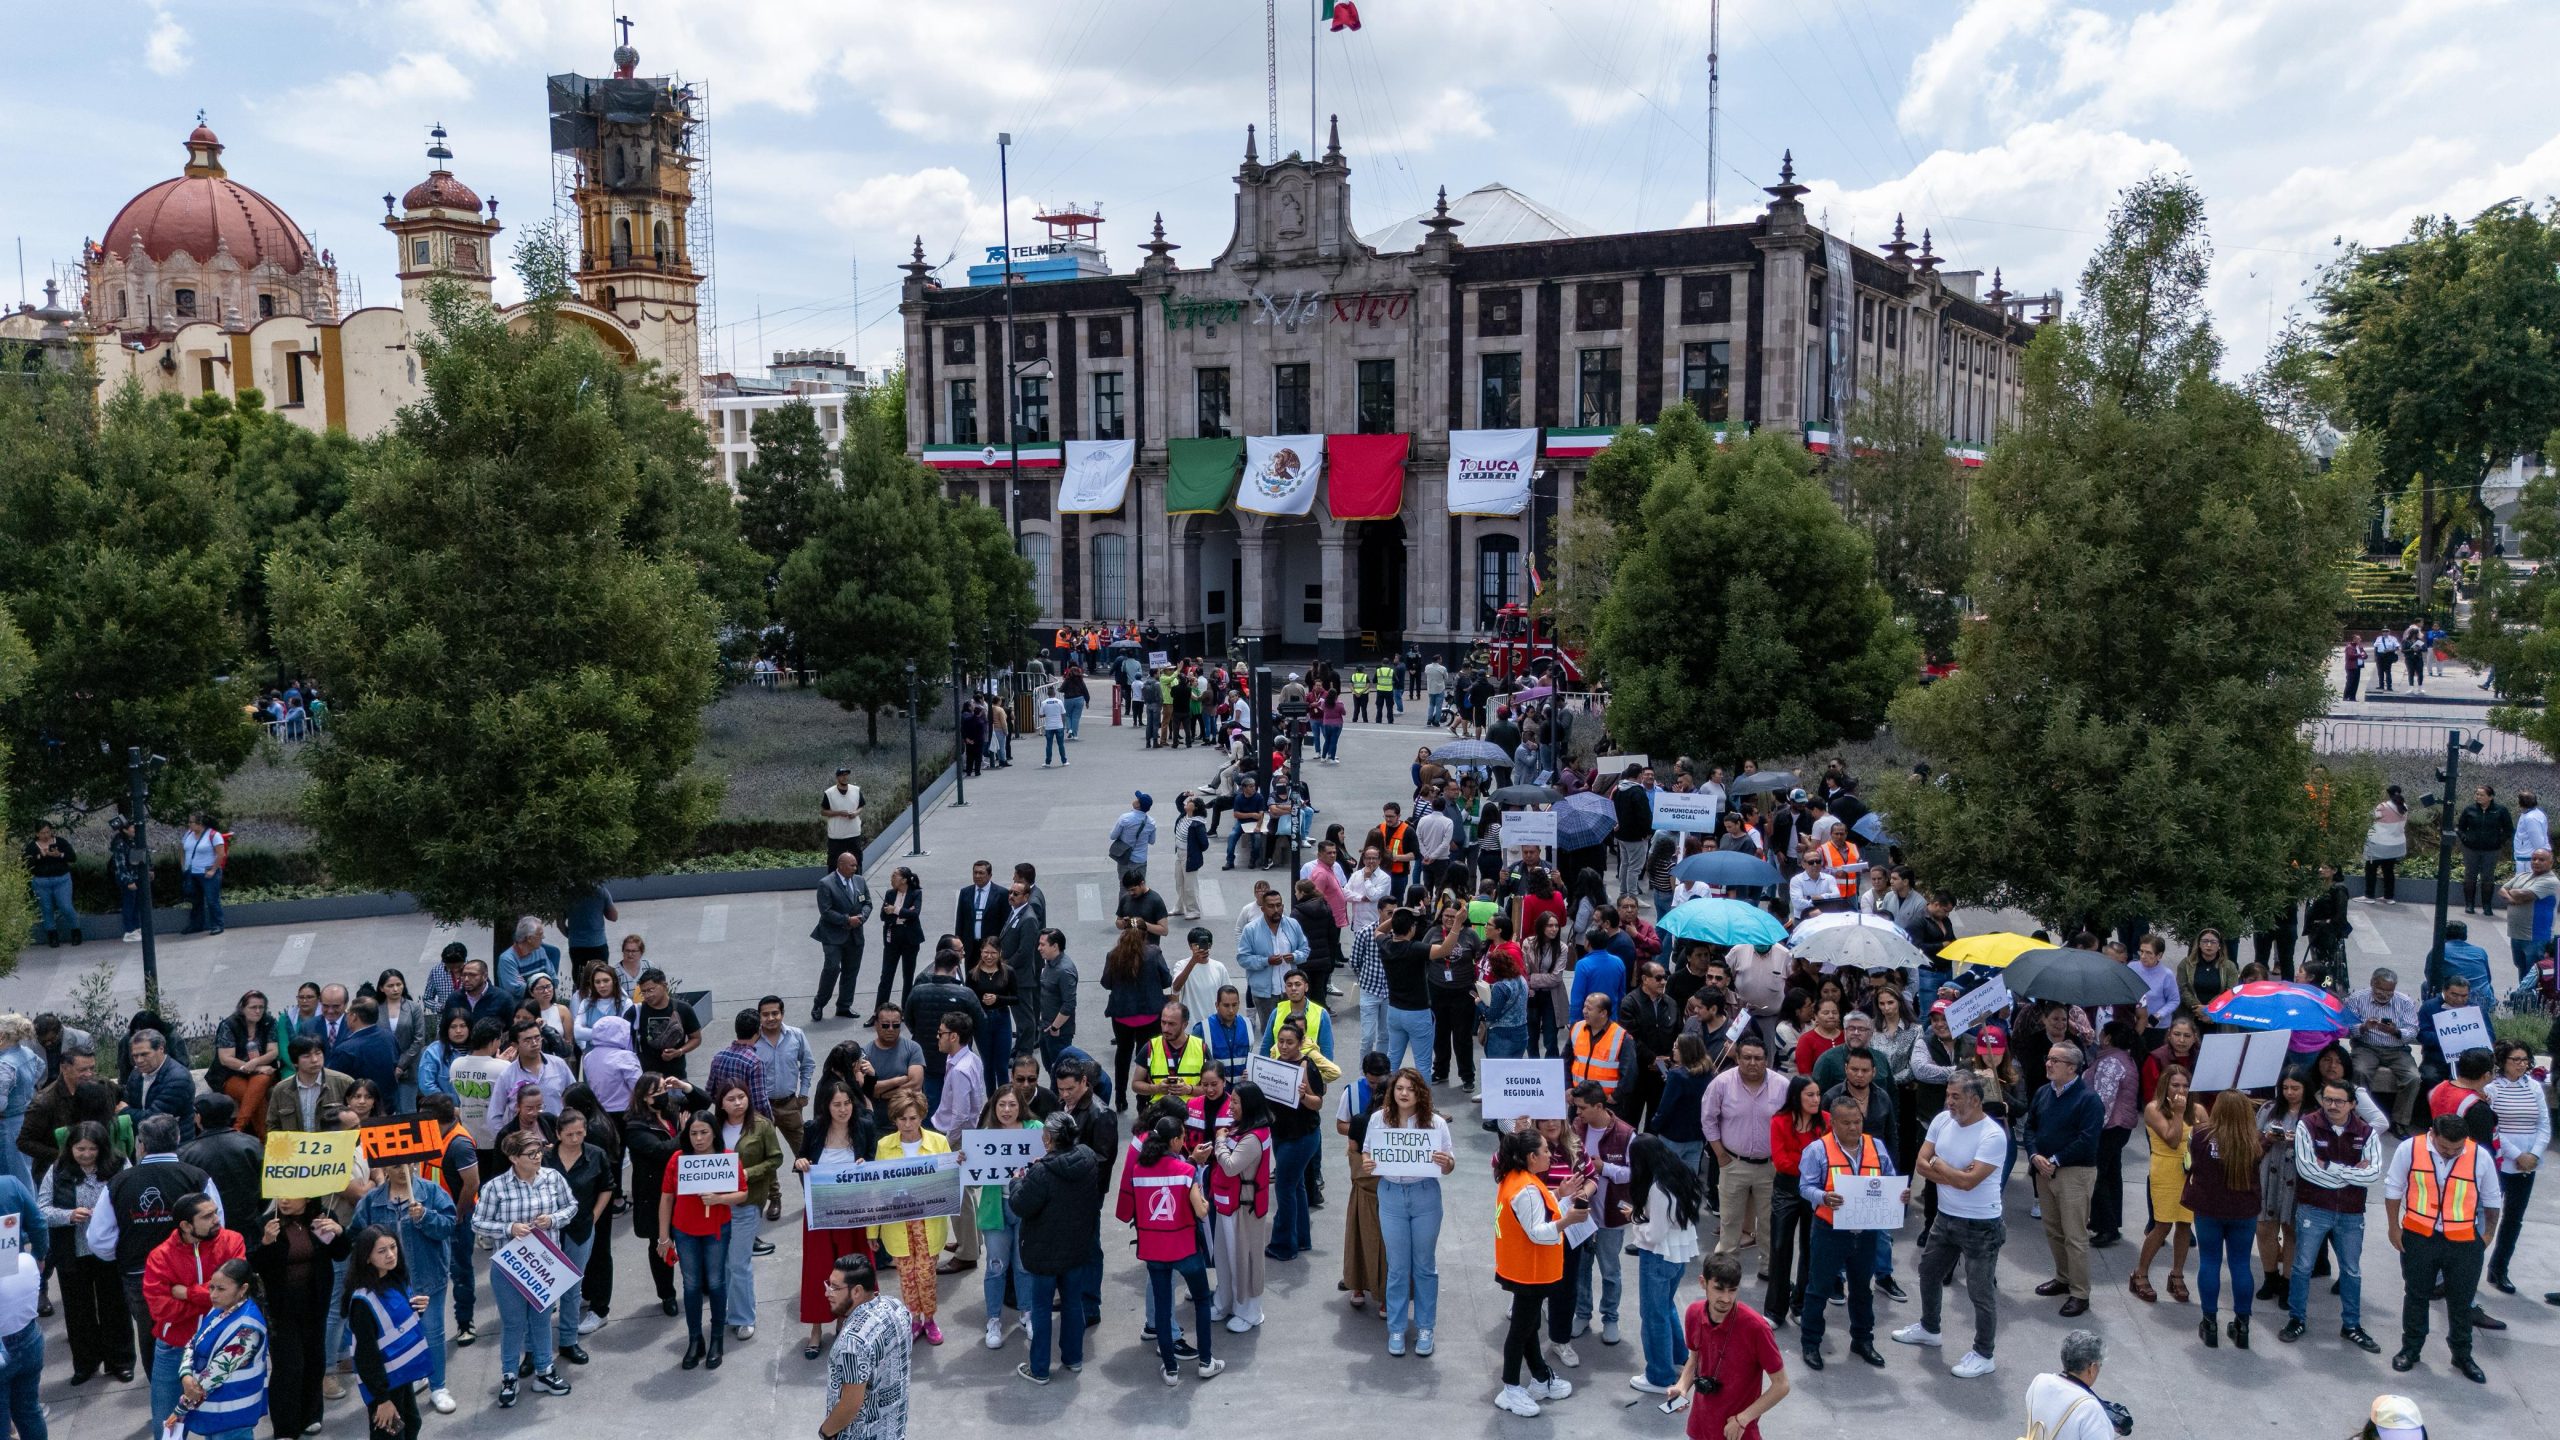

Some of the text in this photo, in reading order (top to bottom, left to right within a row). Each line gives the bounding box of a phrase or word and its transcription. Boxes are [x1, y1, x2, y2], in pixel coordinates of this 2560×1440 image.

[1011, 243, 1067, 257] TELMEX
[1460, 459, 1519, 472] TOLUCA
[1660, 807, 1710, 815] COMUNICACIÓN
[2439, 1022, 2480, 1037] Mejora
[455, 1071, 487, 1080] JUST FOR
[1505, 1077, 1541, 1085] SEGUNDA
[1503, 1087, 1545, 1096] REGIDURÍA
[1384, 1132, 1431, 1146] TERCERA
[1373, 1147, 1437, 1163] REGIDURÍ
[265, 1162, 346, 1179] REGIDURIA
[684, 1158, 730, 1169] OCTAVA
[679, 1170, 735, 1182] REGIDURIA
[835, 1162, 936, 1183] SÉPTIMA REGIDURÍA
[517, 1246, 556, 1287] DÉCIMA
[501, 1250, 551, 1303] REGIDURÍA
